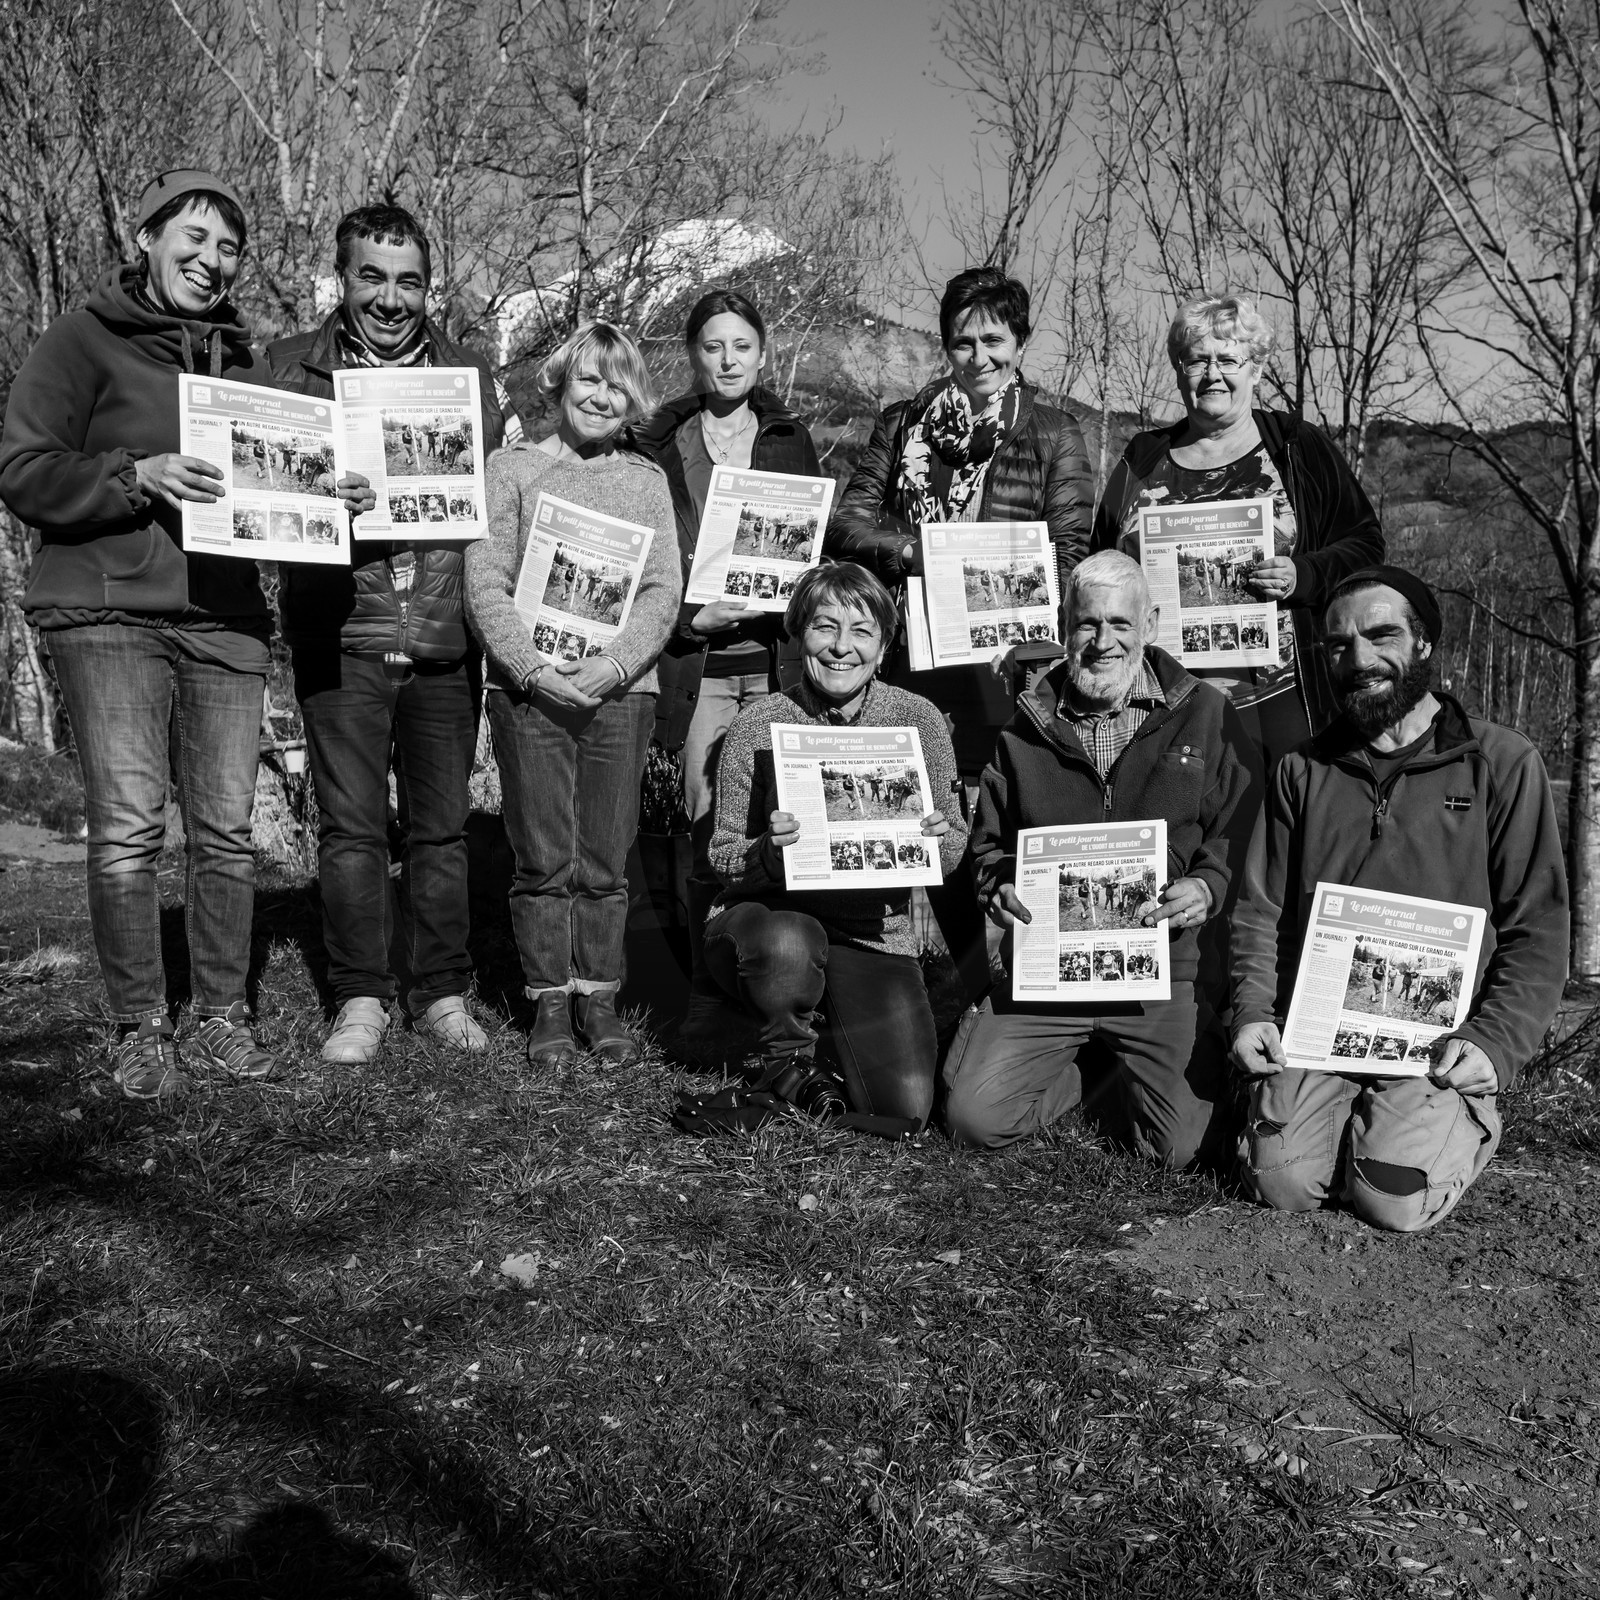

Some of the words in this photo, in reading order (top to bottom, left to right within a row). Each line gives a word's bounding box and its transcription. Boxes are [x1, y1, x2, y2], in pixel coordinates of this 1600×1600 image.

[218, 391, 228, 401] Le
[247, 397, 282, 408] journal
[1166, 517, 1174, 527] Le
[1175, 516, 1190, 526] petit
[1190, 514, 1218, 526] journal
[1049, 837, 1058, 846] Le
[1059, 836, 1076, 846] petit
[1075, 834, 1107, 845] journal
[1351, 900, 1360, 912] Le
[1360, 904, 1381, 914] petit
[1378, 906, 1417, 920] journal
[1384, 918, 1393, 926] DE
[1415, 923, 1424, 932] DE
[1372, 937, 1388, 946] AUTRE
[1388, 940, 1408, 949] REGARD
[1426, 947, 1444, 956] GRAND
